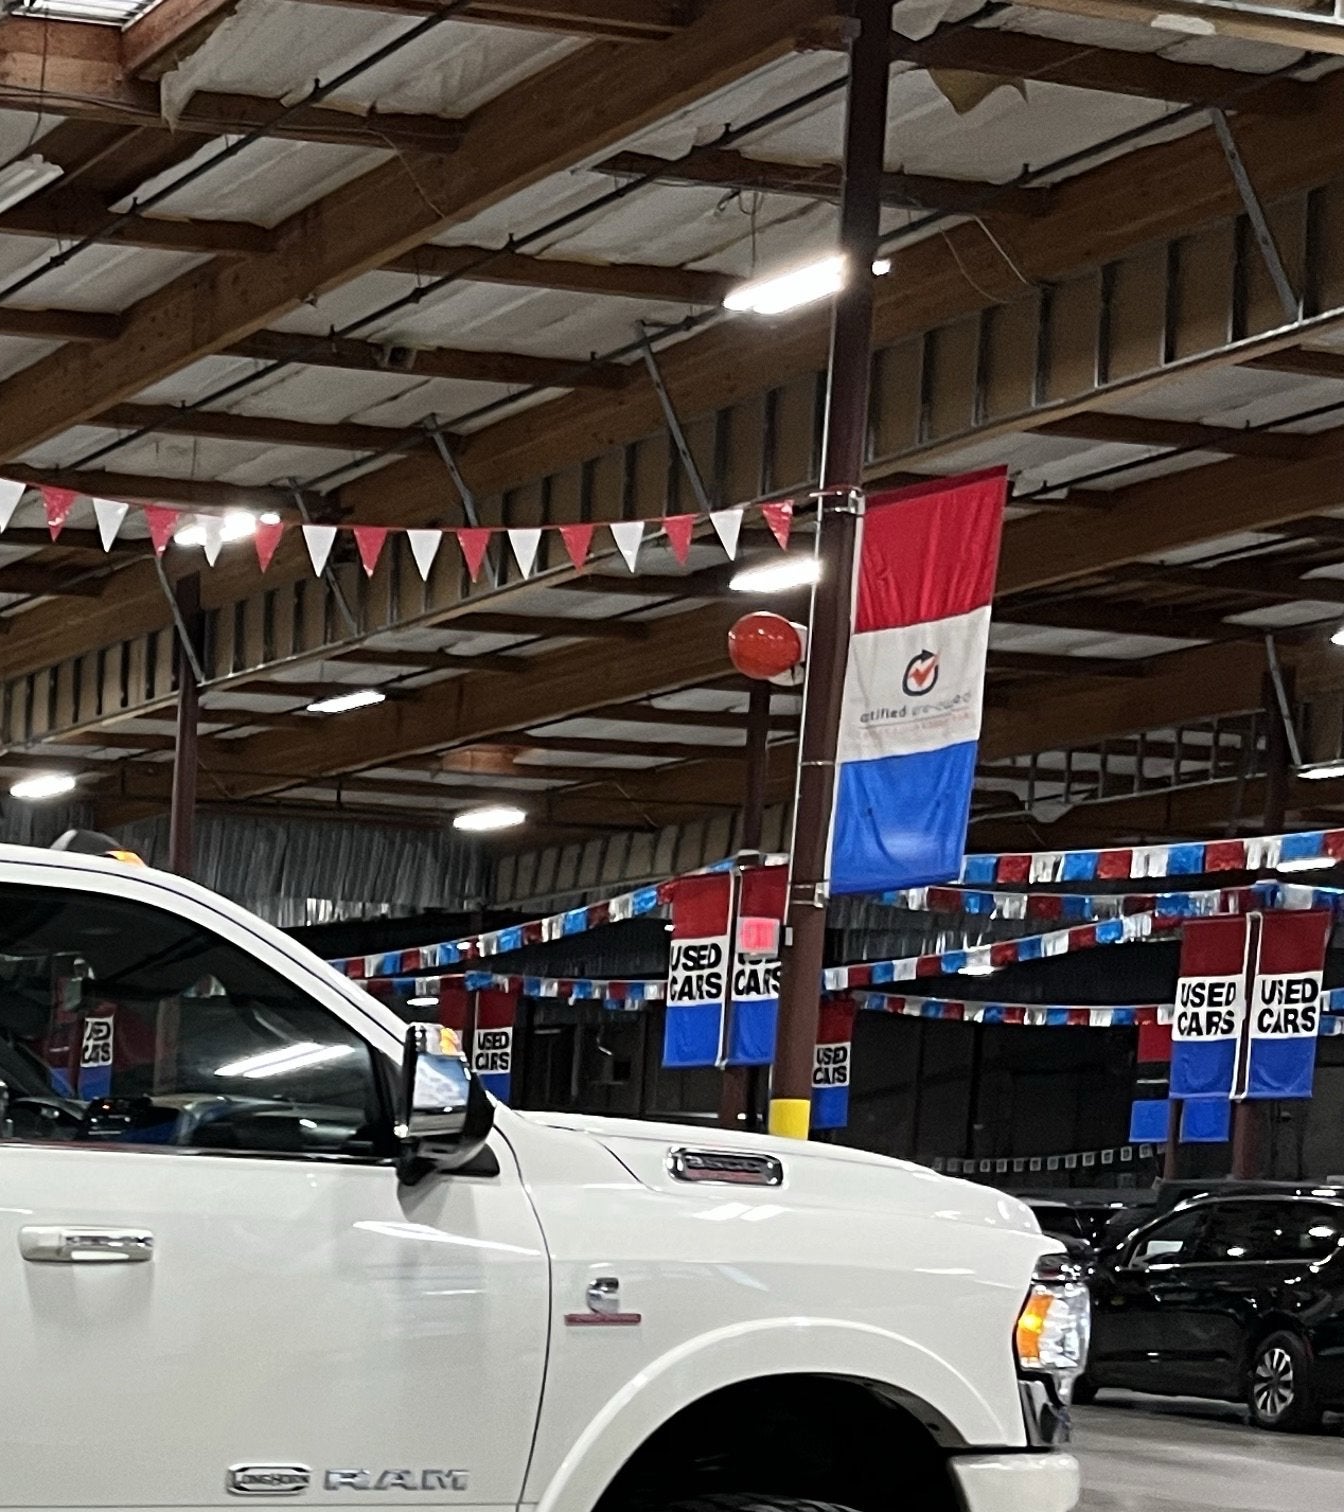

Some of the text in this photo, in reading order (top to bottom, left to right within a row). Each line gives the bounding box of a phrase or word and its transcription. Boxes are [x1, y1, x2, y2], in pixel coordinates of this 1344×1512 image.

[671, 943, 722, 971] USED
[670, 972, 722, 1001] CARS
[1181, 982, 1237, 1008] USED
[1261, 978, 1319, 1005] USED
[1177, 1010, 1235, 1036] CARS
[1257, 1006, 1317, 1034] CARS
[477, 1031, 510, 1051] USED
[324, 1469, 470, 1491] RAM
